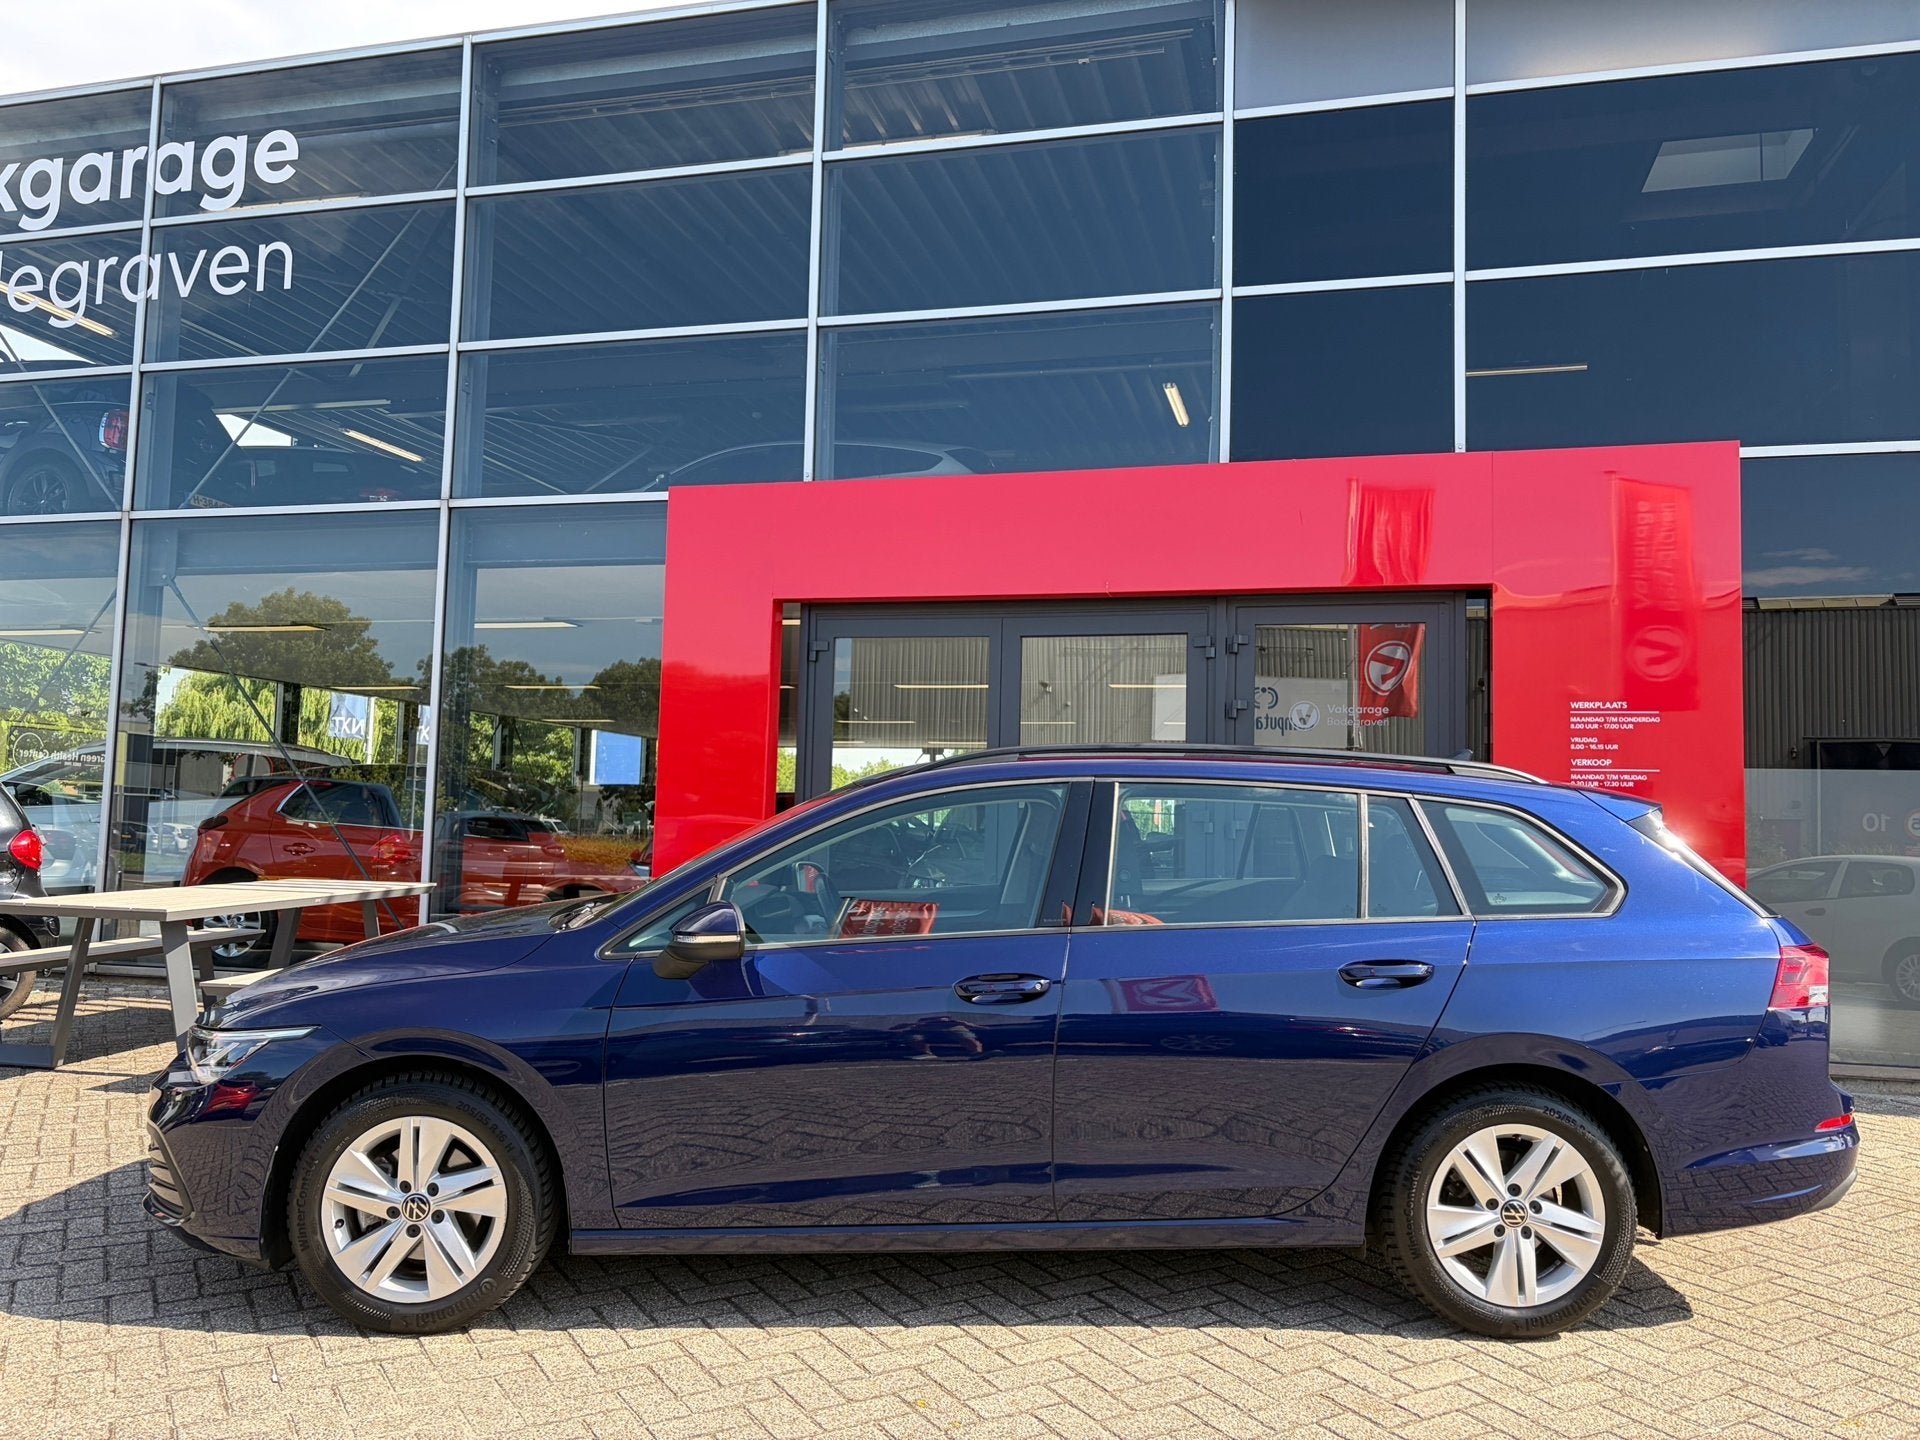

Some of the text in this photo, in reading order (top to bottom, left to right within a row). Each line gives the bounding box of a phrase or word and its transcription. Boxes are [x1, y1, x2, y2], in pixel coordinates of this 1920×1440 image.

[0, 241, 294, 328] egraven
[1327, 704, 1390, 717] Vakgarage
[1570, 701, 1628, 709] WERKPLAATS
[1571, 758, 1612, 766] VERKOOP
[1543, 1105, 1577, 1127] 205/55
